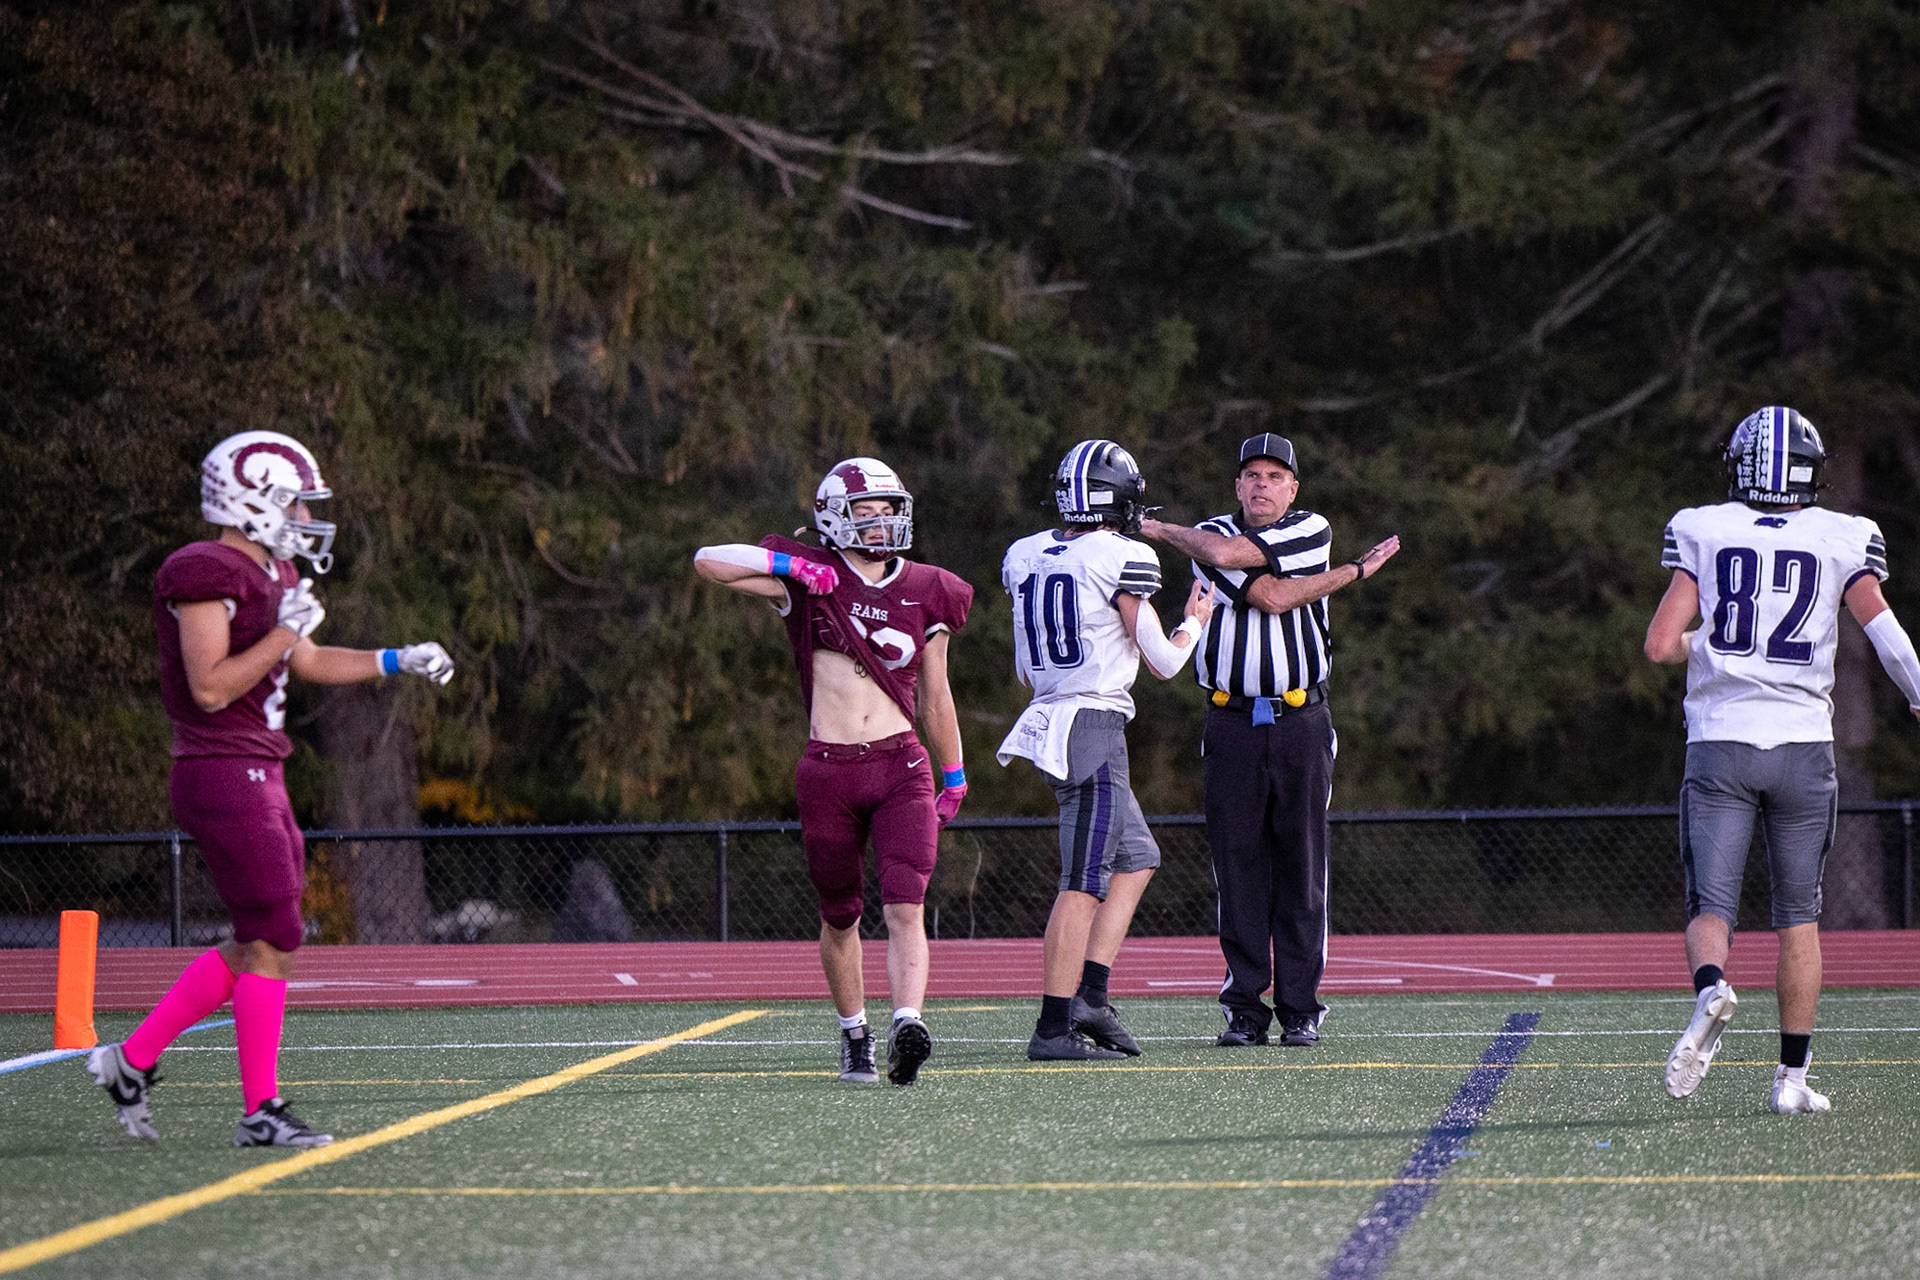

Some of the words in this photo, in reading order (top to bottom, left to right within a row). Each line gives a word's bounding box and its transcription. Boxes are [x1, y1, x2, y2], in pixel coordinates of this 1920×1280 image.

[1749, 489, 1799, 504] Riddell
[1063, 513, 1103, 523] Riddell
[850, 602, 889, 622] RAMS
[1708, 547, 1821, 666] 82
[1018, 573, 1084, 671] 10
